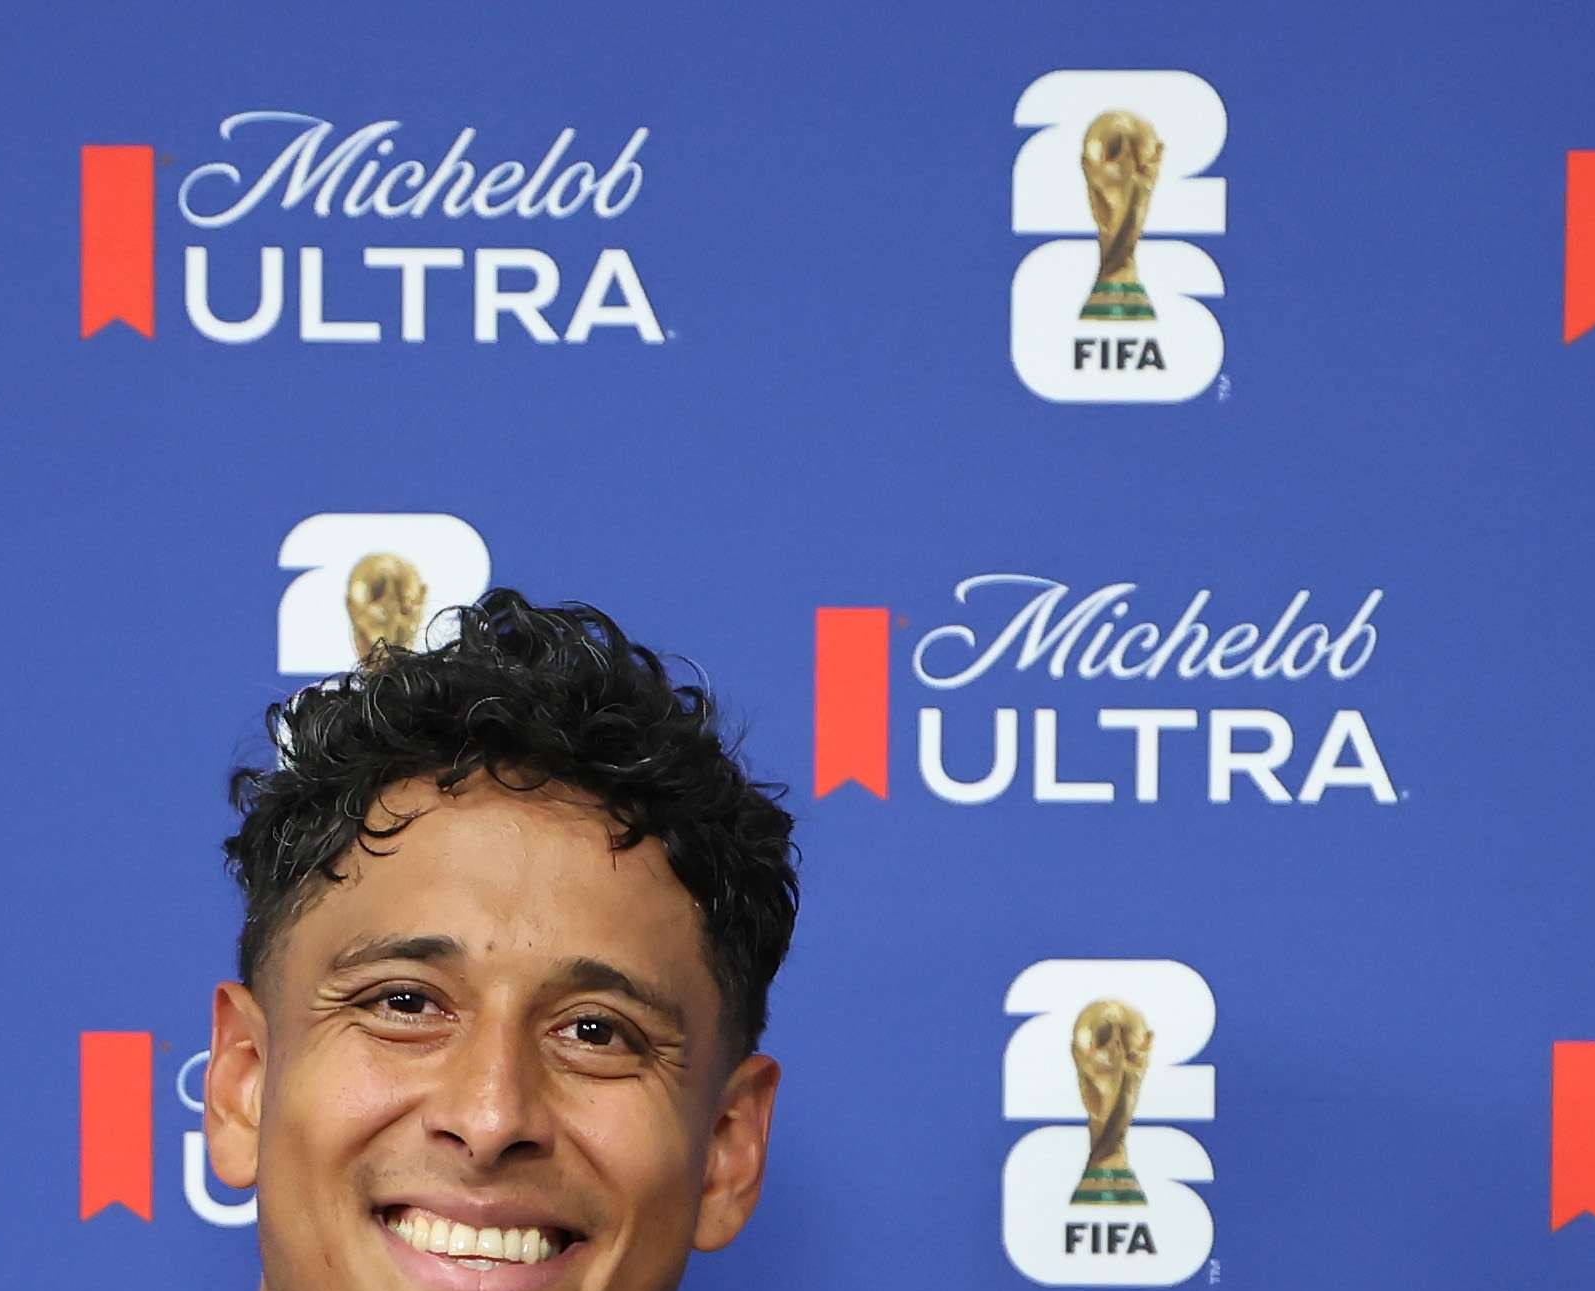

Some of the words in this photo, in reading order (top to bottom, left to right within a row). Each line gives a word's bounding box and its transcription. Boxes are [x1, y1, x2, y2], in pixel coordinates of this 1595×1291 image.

[178, 111, 649, 228] Michelob
[185, 246, 665, 344] ULTRA
[1075, 340, 1164, 369] FIFA
[912, 574, 1383, 690] Michelob
[918, 708, 1397, 805] ULTRA
[1066, 1224, 1155, 1253] FIFA
